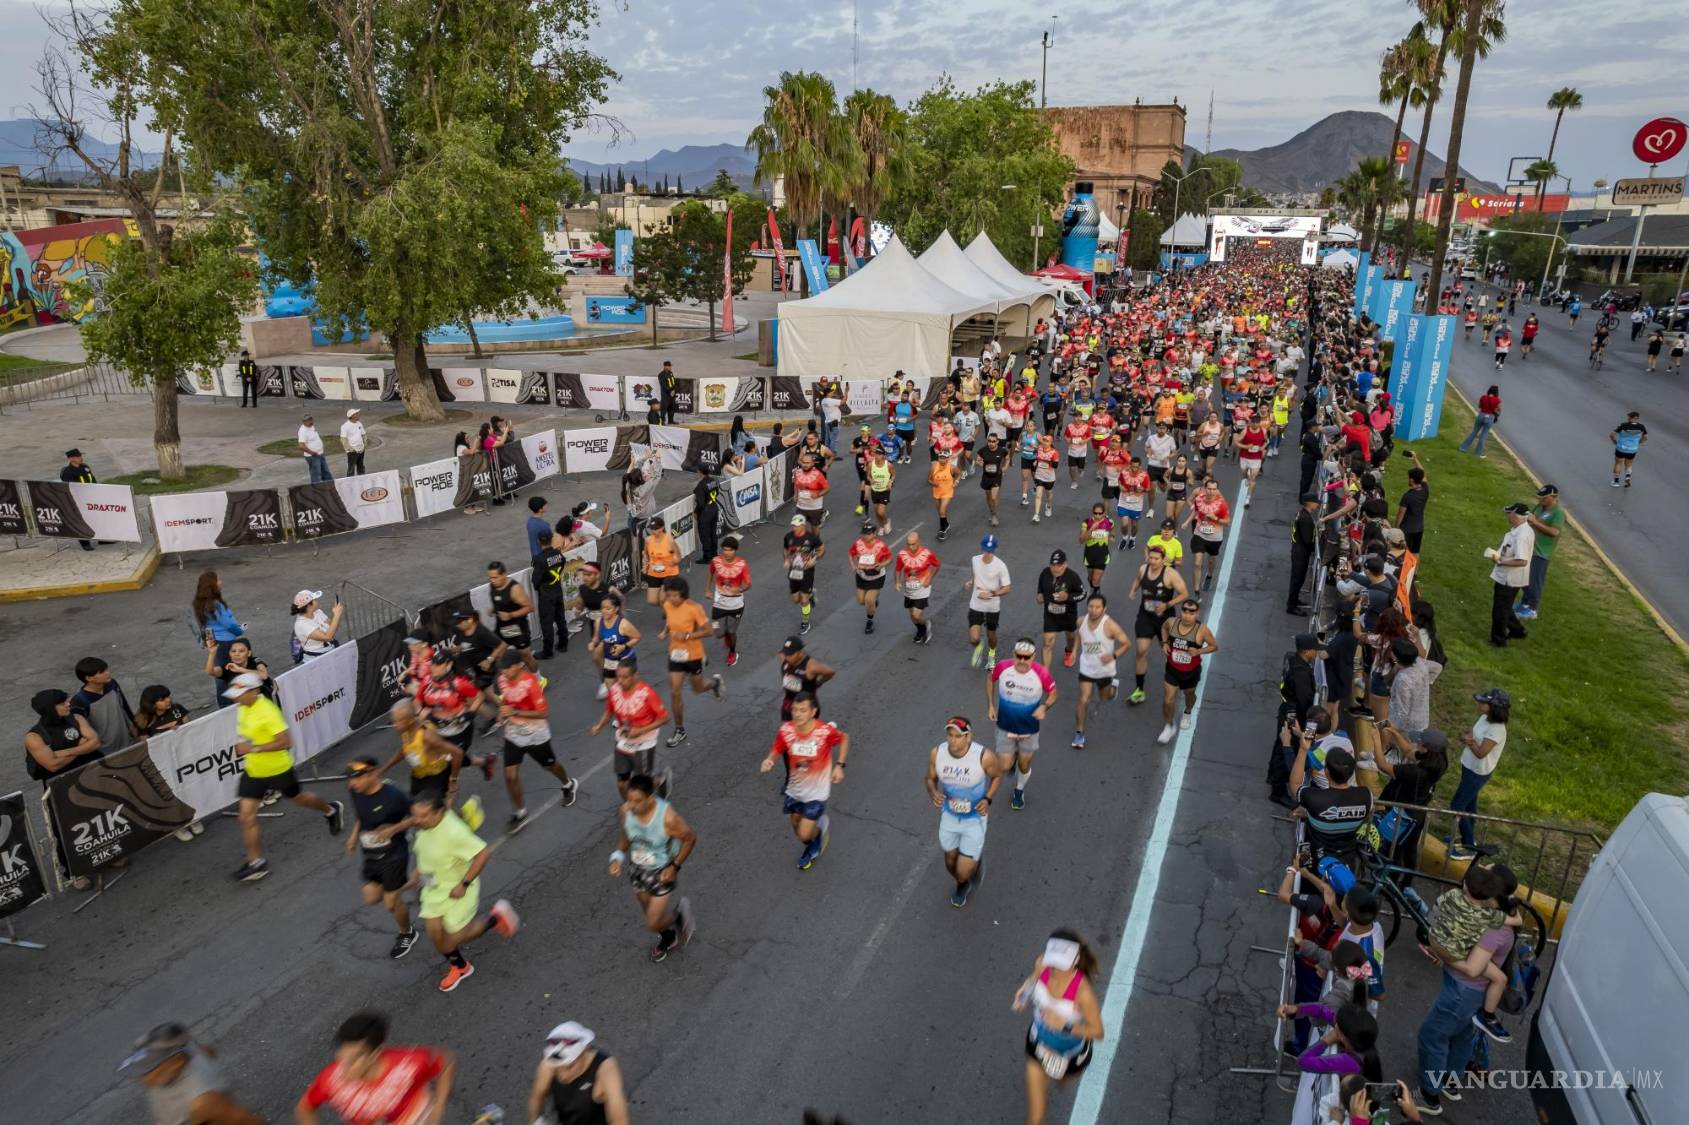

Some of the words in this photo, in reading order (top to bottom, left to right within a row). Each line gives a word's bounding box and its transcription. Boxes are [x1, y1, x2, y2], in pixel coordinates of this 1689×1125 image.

[1617, 183, 1682, 195] MARTINS
[557, 389, 572, 397] 21K
[676, 393, 690, 401] 21K
[747, 392, 762, 400] 21K
[773, 392, 789, 400] 21K
[567, 439, 608, 448] POWER
[585, 445, 608, 454] ADE
[701, 450, 718, 460] 21K
[502, 464, 517, 478] 21K
[415, 472, 453, 487] POWER
[473, 471, 491, 485] 21K
[432, 480, 453, 492] ADE
[37, 507, 61, 520] 21K
[86, 504, 127, 513] DRAXTON
[297, 507, 323, 523] 21K
[248, 513, 278, 526] 21K
[611, 557, 629, 577] 21K
[380, 654, 407, 682] 21K
[294, 687, 345, 722] IDEMSPORT
[176, 745, 234, 784] POW
[218, 757, 246, 782] AD
[71, 803, 128, 846] 21K
[75, 824, 131, 853] COAHUILA
[91, 848, 111, 864] 21K
